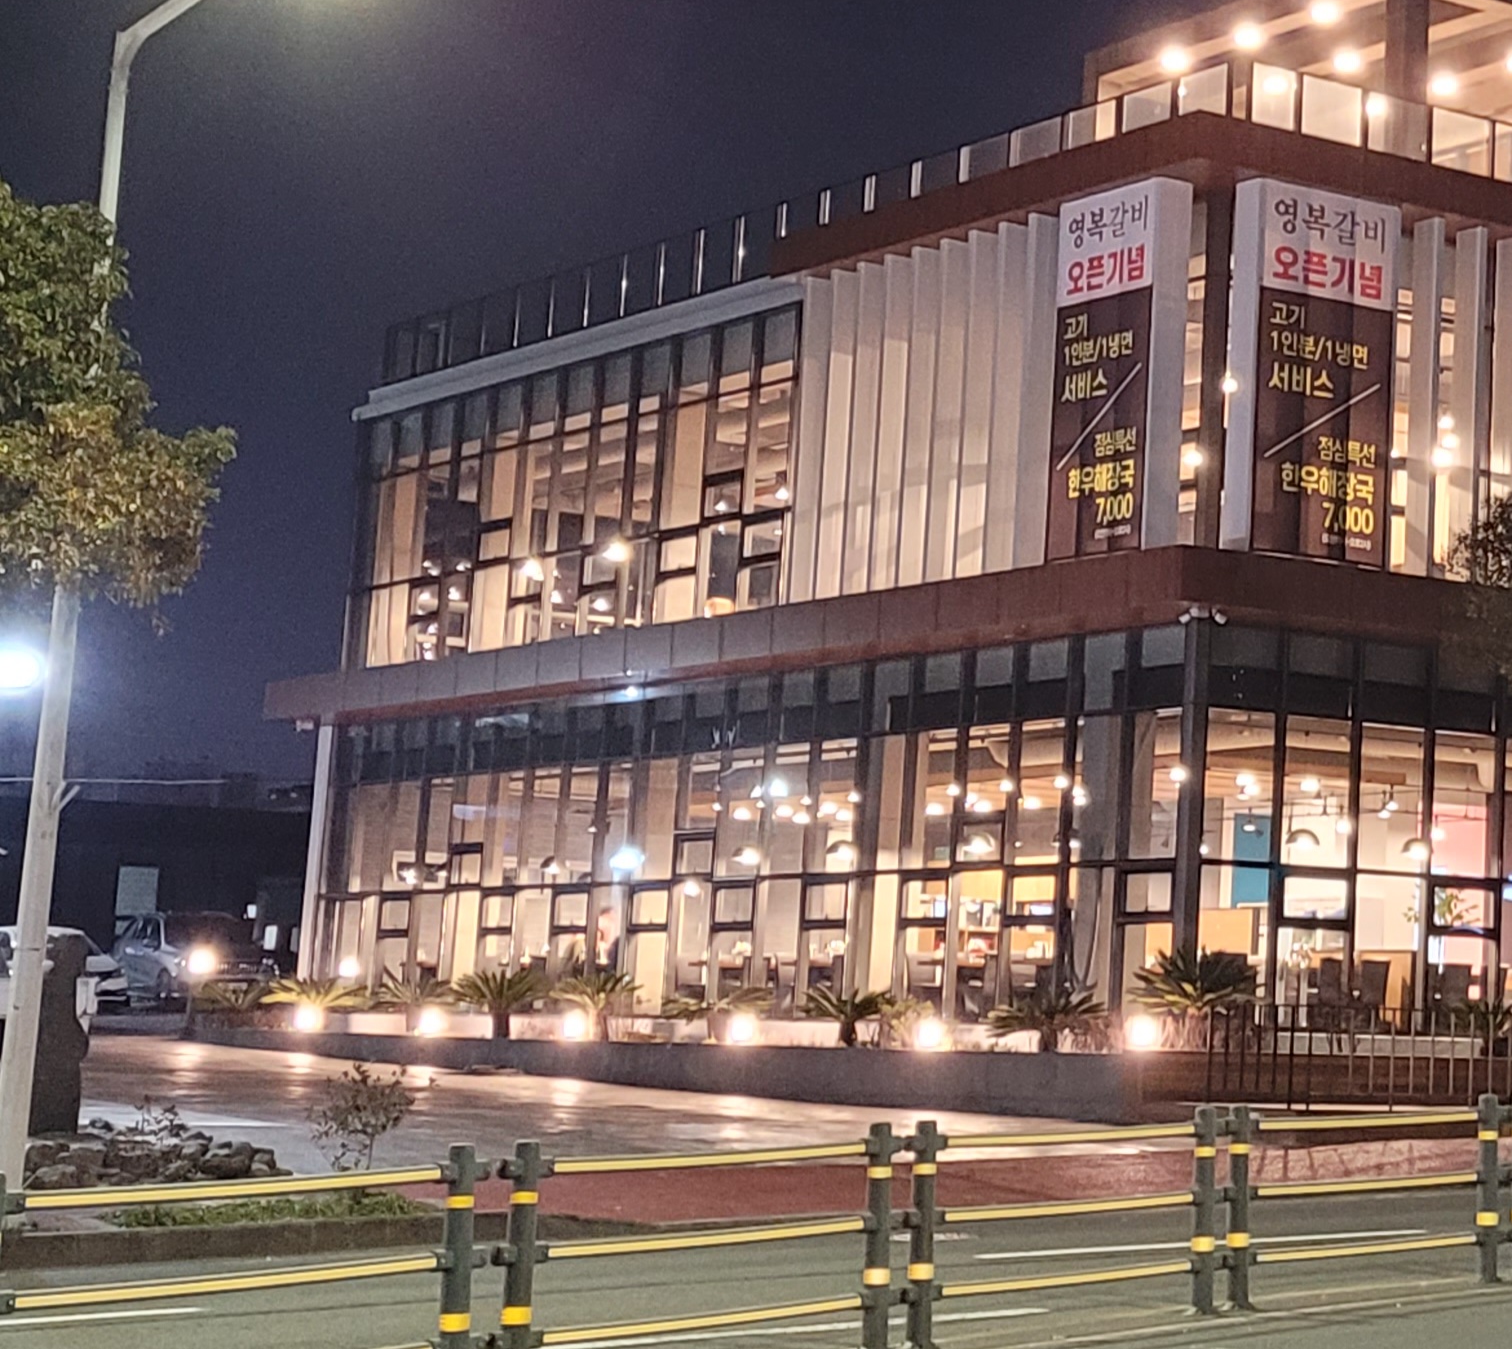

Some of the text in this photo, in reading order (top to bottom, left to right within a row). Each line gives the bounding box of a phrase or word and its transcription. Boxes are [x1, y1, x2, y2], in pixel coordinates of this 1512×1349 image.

[1068, 195, 1149, 249] 영복갈비
[1274, 197, 1387, 254] 영복갈비
[1066, 244, 1145, 295] 오픈기념
[1272, 246, 1383, 300] 오픈기념
[1063, 314, 1088, 340] 고기
[1270, 302, 1305, 329] 고기
[1064, 331, 1133, 367] 1인분/1냉면
[1270, 331, 1369, 370] 1인분/1냉면
[1061, 368, 1108, 403] 서비스
[1268, 362, 1335, 399] 서비스
[1093, 427, 1137, 457] 점심특선
[1318, 435, 1376, 468] 점심특선
[1067, 460, 1135, 499] 한우해장국
[1281, 461, 1375, 505] 한우해장국
[1095, 492, 1133, 526] 7,000
[1321, 501, 1375, 535] 7,000
